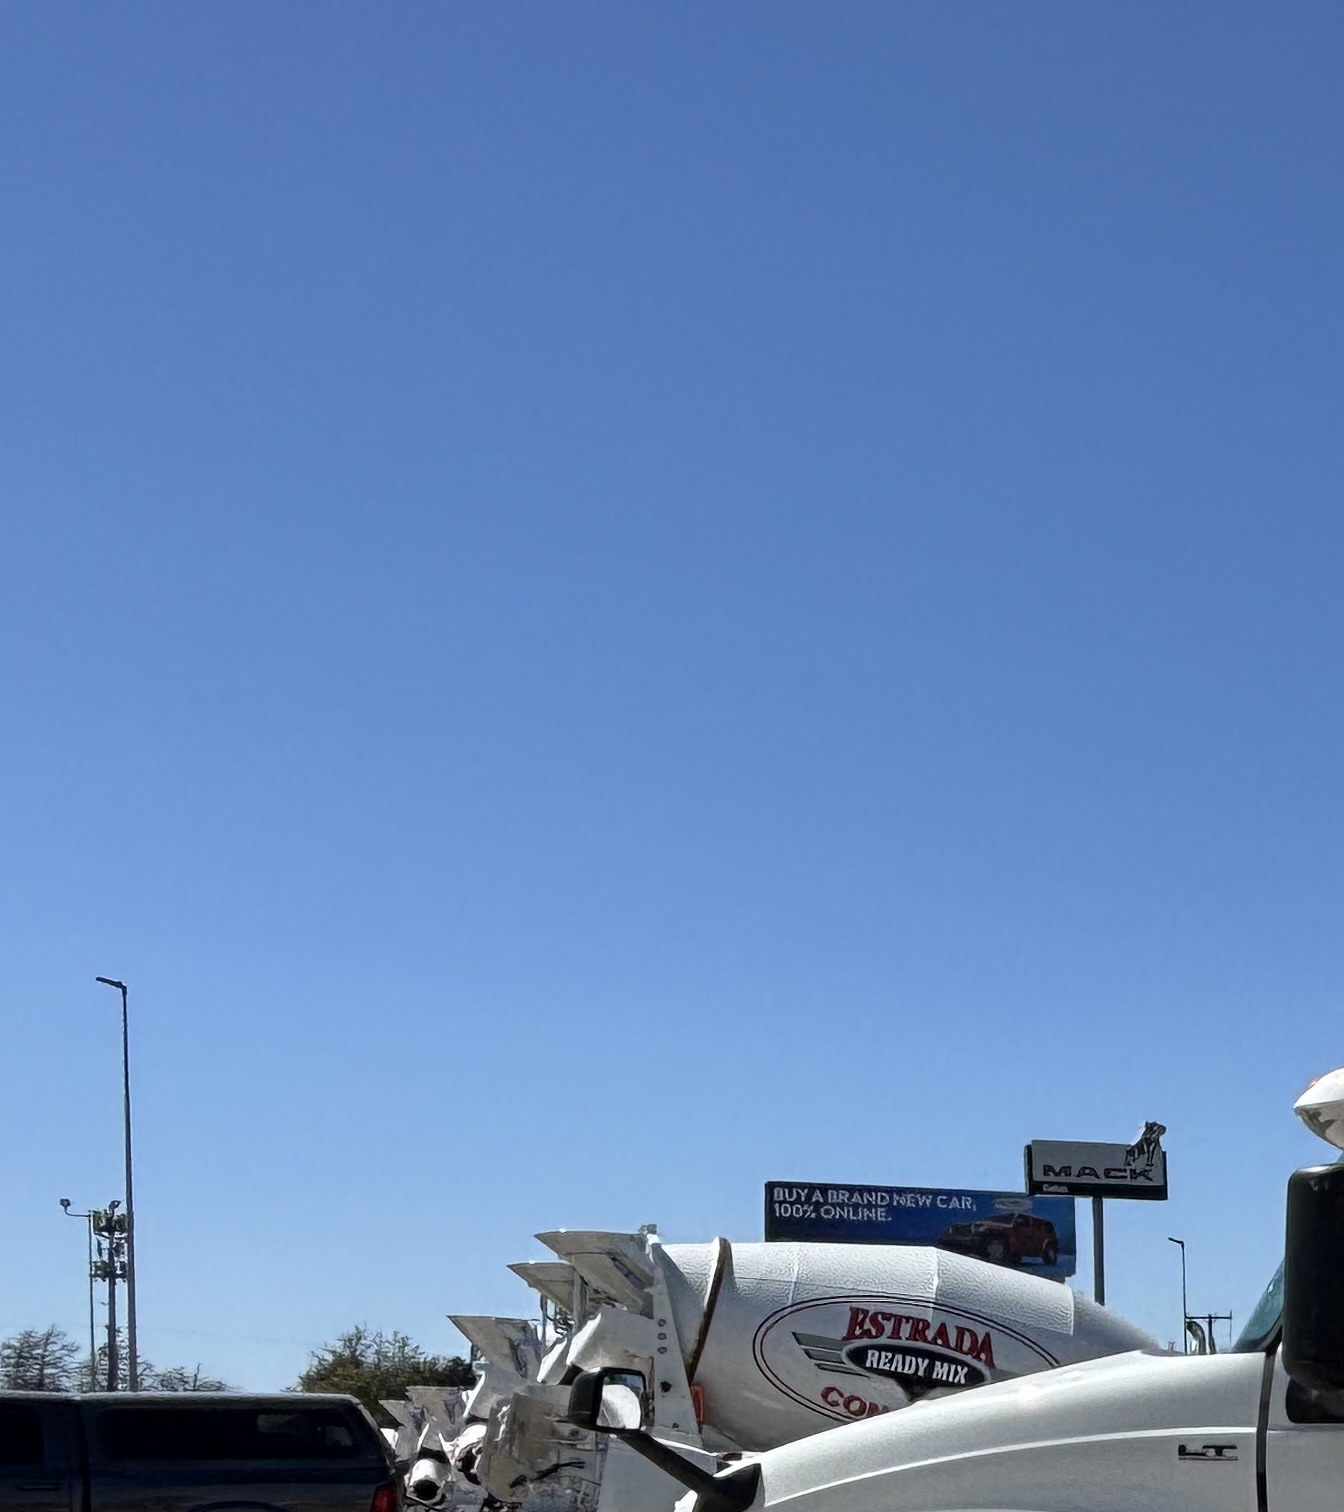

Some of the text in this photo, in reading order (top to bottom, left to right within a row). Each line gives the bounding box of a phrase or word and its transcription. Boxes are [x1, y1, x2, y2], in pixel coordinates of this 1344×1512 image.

[1043, 1164, 1154, 1182] MACK
[773, 1187, 808, 1202] BUY
[812, 1189, 825, 1203] A
[828, 1190, 890, 1206] BRAND
[893, 1193, 933, 1208] NEW
[774, 1203, 816, 1219] 100%
[841, 1306, 997, 1369] ESTRADA
[865, 1349, 969, 1385] READY MIX
